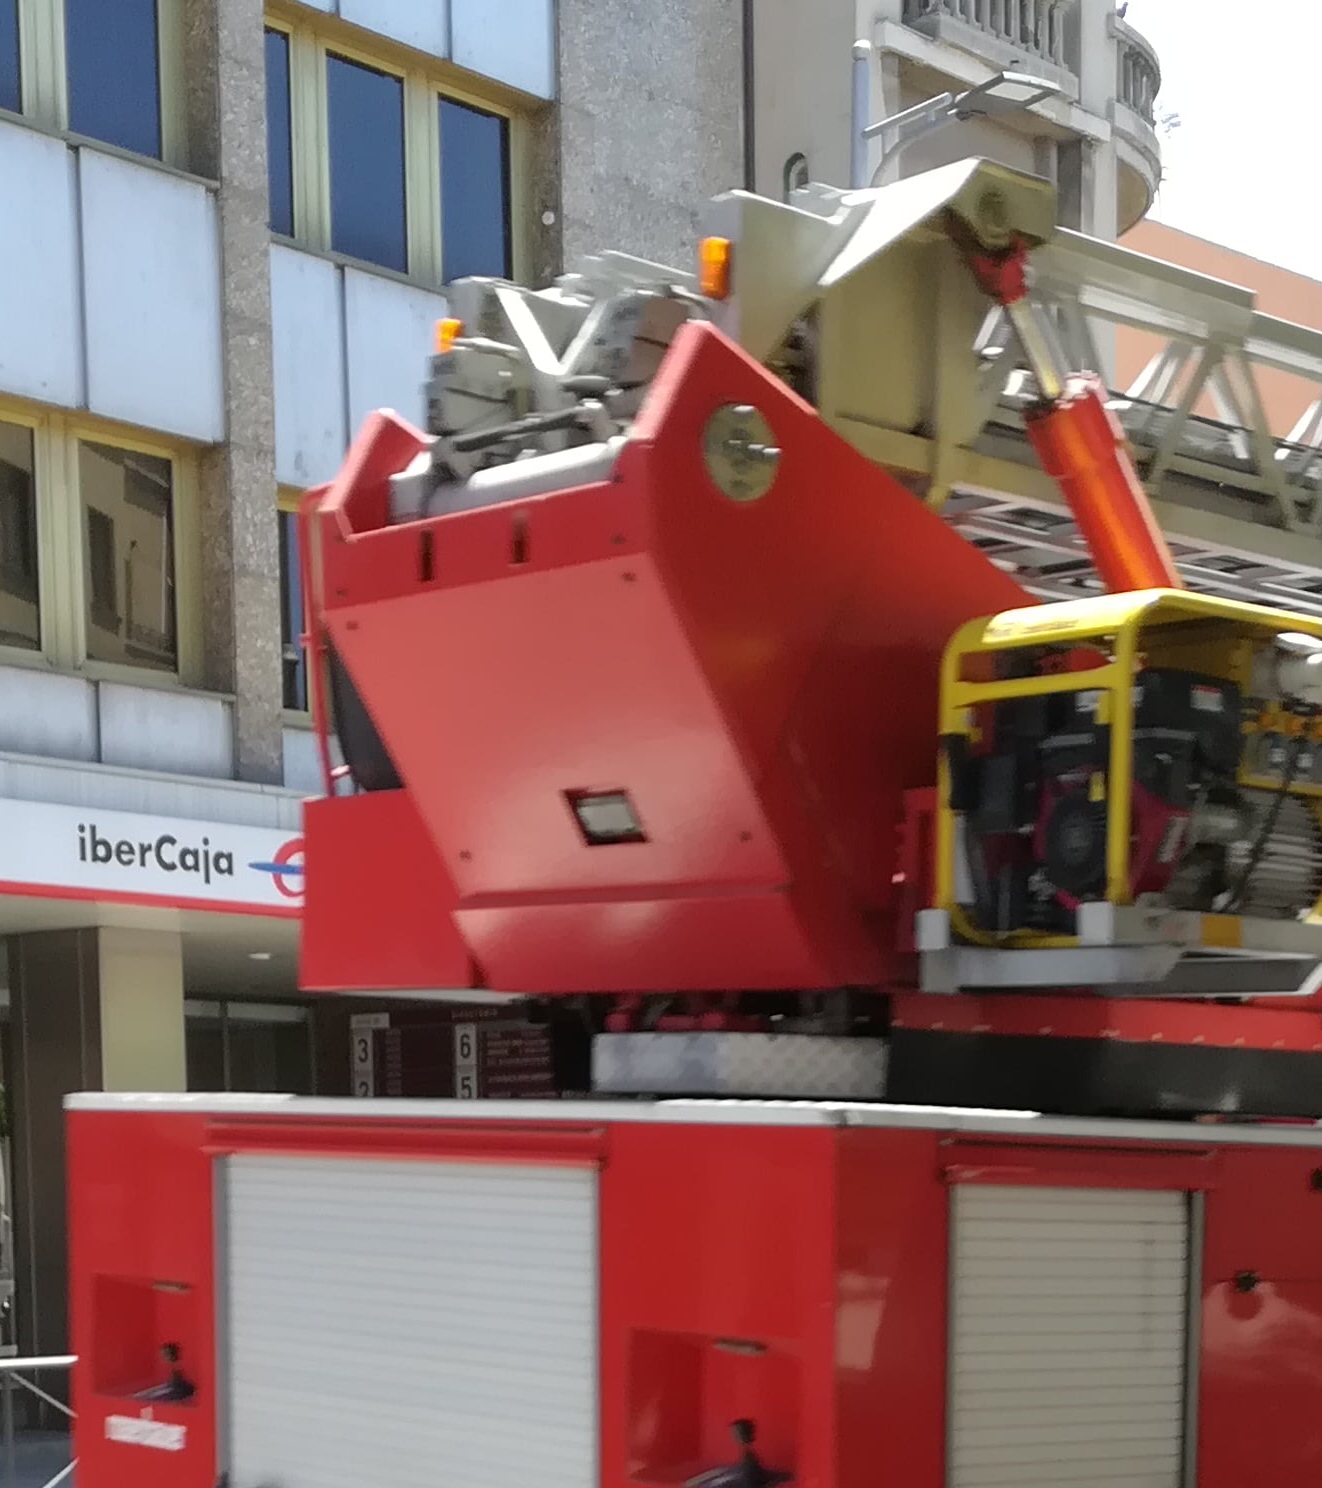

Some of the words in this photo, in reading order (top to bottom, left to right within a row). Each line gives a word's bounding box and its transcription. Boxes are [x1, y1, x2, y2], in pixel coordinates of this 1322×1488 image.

[77, 823, 234, 884] iberCaja
[357, 1037, 369, 1063] 3
[459, 1033, 471, 1060] 6
